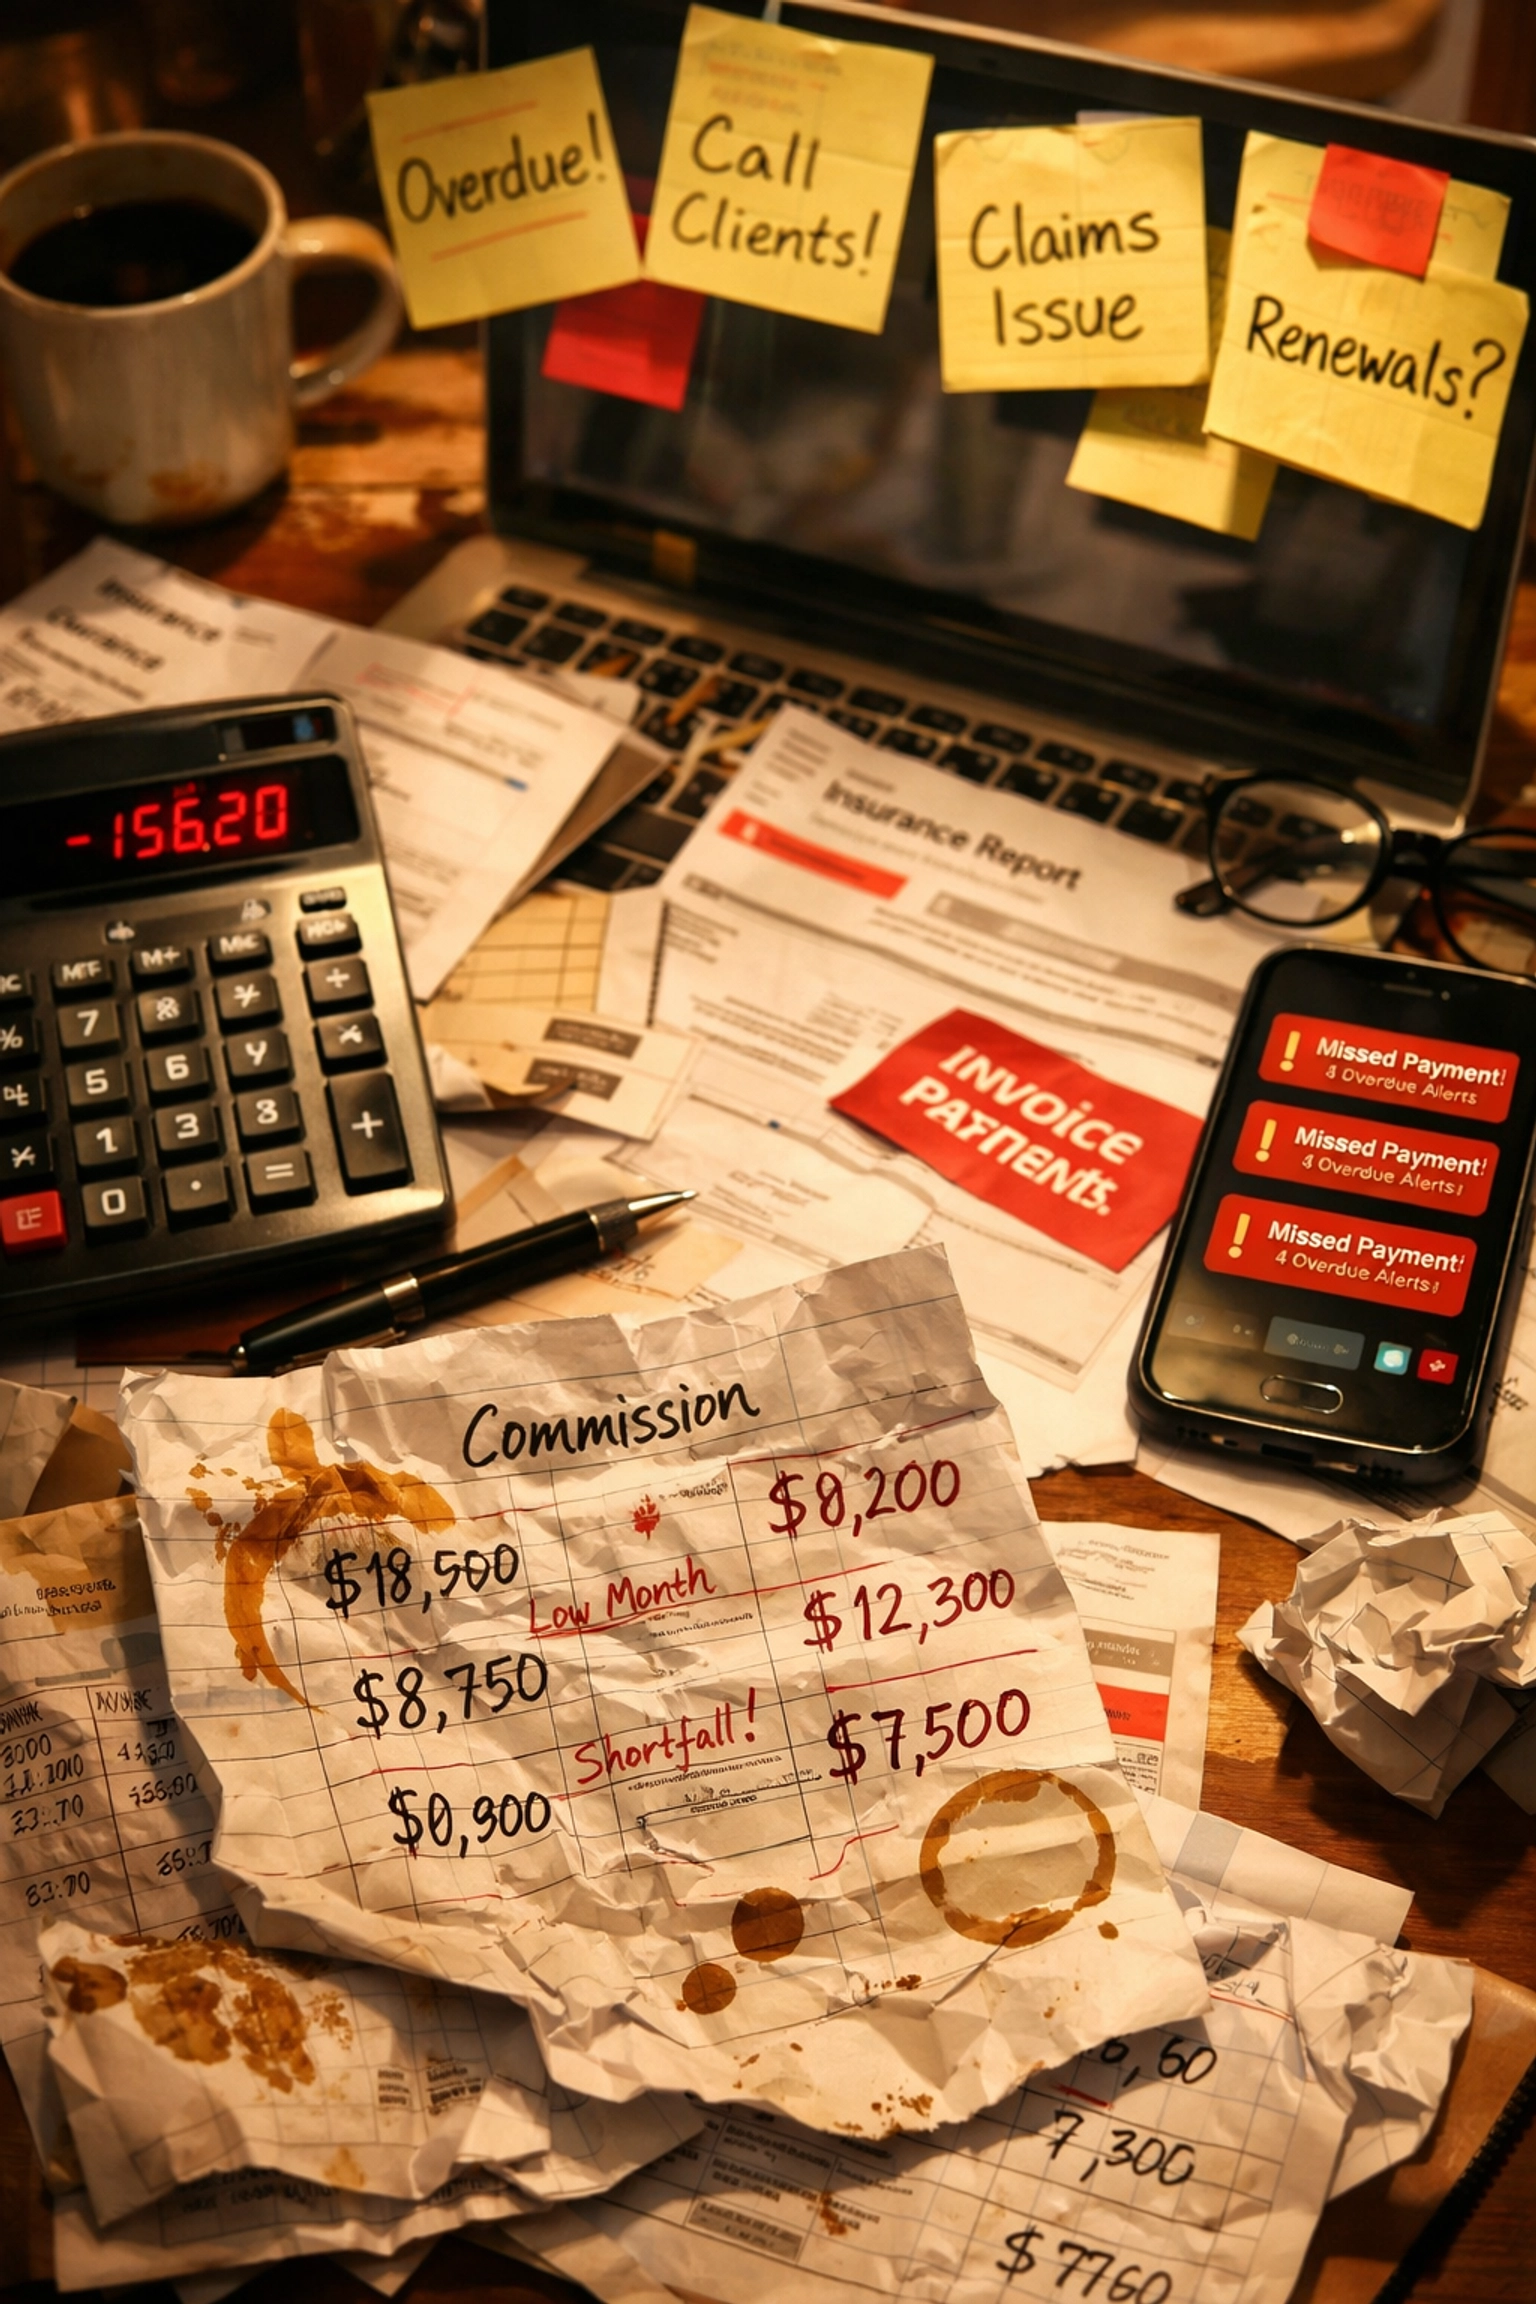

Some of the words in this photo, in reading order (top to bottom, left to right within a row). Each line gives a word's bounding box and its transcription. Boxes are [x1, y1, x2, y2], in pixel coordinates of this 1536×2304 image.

[397, 110, 607, 224] Overdue!
[691, 113, 820, 192] Call
[671, 191, 882, 278] Clients!
[968, 202, 1161, 271] Claims
[992, 287, 1145, 348] Issue
[1245, 293, 1507, 422] Renewals?
[821, 779, 971, 851] Insurance
[972, 831, 1083, 892] Report
[77, 1009, 101, 1037] 7
[85, 1067, 109, 1095] 5
[164, 1054, 190, 1081] 6
[1315, 1036, 1398, 1069] Missed
[1402, 1051, 1507, 1087] Payment!
[1341, 1067, 1417, 1094] Overdue
[96, 1127, 119, 1154] 1
[174, 1112, 200, 1140] 3
[1294, 1126, 1378, 1158] Missed
[1381, 1140, 1488, 1177] Payment!
[1317, 1156, 1395, 1183] Overdue
[101, 1187, 127, 1216] 0
[1267, 1220, 1352, 1253] Missed
[1356, 1235, 1466, 1274] Payment!
[1274, 1249, 1287, 1266] 4
[1292, 1253, 1371, 1281] Overdue
[462, 1382, 760, 1468] Commission
[323, 1543, 520, 1619] $18,500
[528, 1598, 591, 1634] Low
[606, 1555, 717, 1618] Month
[803, 1568, 1016, 1653] $12,300
[353, 1652, 549, 1739] $8,750
[573, 1687, 757, 1784] Shortfall!
[826, 1688, 1031, 1785] $7,500
[1047, 2109, 1196, 2187] 7,300
